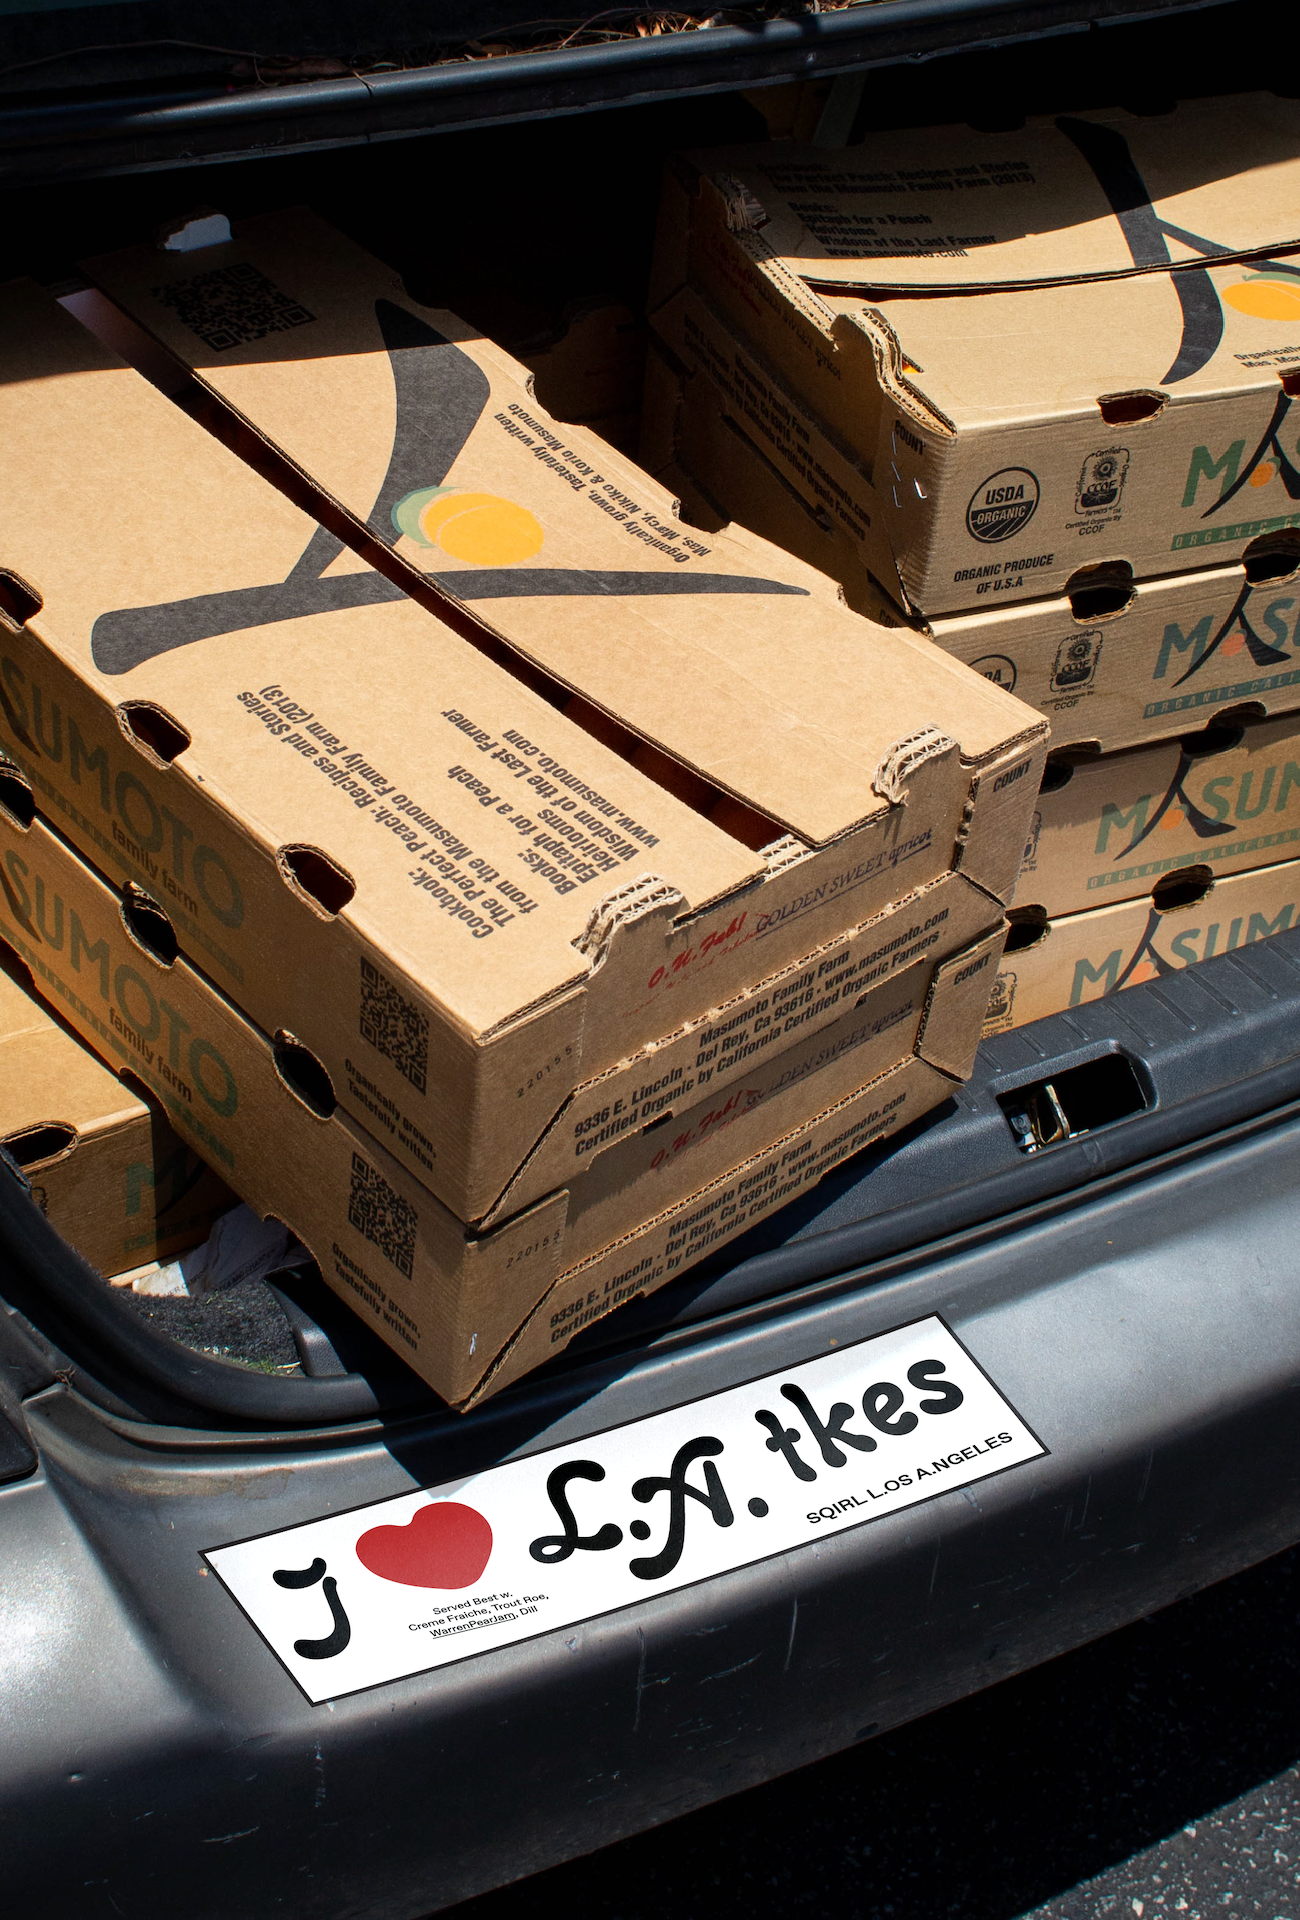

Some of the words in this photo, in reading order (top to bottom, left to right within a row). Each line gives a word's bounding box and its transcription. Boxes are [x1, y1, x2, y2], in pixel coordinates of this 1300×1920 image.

[909, 178, 954, 193] Family
[956, 176, 991, 190] Farm
[992, 171, 1036, 188] (2013)
[955, 164, 980, 176] and
[888, 213, 932, 225] Peach
[875, 235, 889, 247] of
[890, 235, 915, 248] the
[916, 234, 946, 247] Last
[947, 232, 998, 246] Farmer
[494, 413, 535, 446] written
[507, 403, 565, 451] Masumoto
[531, 447, 586, 491] Tastefully
[562, 451, 594, 476] Korio
[590, 473, 606, 486] &
[588, 490, 628, 521] grown,
[603, 485, 641, 514] Nikiko
[985, 485, 1025, 505] USDA
[641, 513, 680, 540] Marcy,
[976, 505, 1026, 524] ORGANIC
[1079, 524, 1105, 536] CCOF
[622, 522, 690, 562] Organically
[682, 537, 711, 556] Mas,
[1176, 520, 1267, 547] ORGANIC
[954, 564, 1001, 583] ORGANIC
[1003, 553, 1054, 575] PRODUCE
[976, 582, 991, 595] OF
[993, 575, 1024, 592] U.S.A
[237, 692, 291, 735] Stories
[259, 685, 314, 724] (2013)
[1054, 699, 1079, 711] CCOF
[1147, 687, 1237, 716] ORGANIC
[281, 733, 319, 757] and
[306, 722, 348, 755] Farm
[441, 710, 499, 752] Farmer
[342, 754, 396, 796] Family
[491, 748, 532, 778] Last
[993, 758, 1033, 793] COUNT
[313, 757, 376, 808] Recipes
[448, 766, 501, 807] Peach
[502, 730, 660, 848] www.masumoto.com
[527, 776, 558, 798] the
[496, 803, 514, 814] a
[550, 796, 577, 811] of
[370, 806, 428, 852] Peach:
[392, 794, 473, 861] Masumoto
[507, 815, 538, 835] for
[537, 809, 620, 872] Heirlooms
[574, 810, 639, 861] Wisdom
[420, 849, 486, 901] Perfect
[468, 859, 500, 883] the
[518, 848, 578, 895] Books:
[533, 833, 599, 883] Epitaph
[827, 851, 887, 893] SWEET
[886, 828, 932, 868] apricot
[1090, 858, 1179, 889] ORGANIC
[163, 868, 201, 918] farm
[408, 868, 494, 938] Cookbook:
[496, 880, 538, 914] from
[481, 898, 515, 927] The
[953, 952, 992, 986] COUNT
[700, 999, 768, 1047] Masumoto
[772, 971, 815, 1005] Family
[818, 951, 850, 978] Farm
[575, 1107, 610, 1138] 9336
[614, 1099, 627, 1116] E.
[632, 1068, 682, 1105] Lincoln
[696, 1044, 718, 1068] Del
[722, 1030, 749, 1053] Rey,
[754, 1016, 771, 1033] Ca
[774, 988, 814, 1021] 93616
[825, 908, 949, 991] www.masumoto.com
[110, 1007, 155, 1064] family
[158, 1055, 193, 1103] farm
[576, 1108, 638, 1156] Certified
[641, 1079, 694, 1117] Organic
[698, 1067, 714, 1084] by
[717, 1027, 781, 1072] California
[784, 988, 840, 1032] Certified
[842, 962, 888, 997] Organic
[891, 931, 939, 968] Farmers
[345, 1059, 400, 1121] Organically
[403, 1117, 436, 1158] grown,
[348, 1078, 396, 1134] Tastefully
[399, 1130, 432, 1171] written
[669, 1190, 734, 1238] Masumoto
[738, 1161, 779, 1195] Family
[781, 1140, 812, 1166] Farm
[550, 1298, 583, 1328] 9336
[587, 1289, 599, 1306] E.
[604, 1257, 652, 1294] Lincoln
[665, 1233, 686, 1256] Del
[690, 1218, 716, 1240] Rey,
[720, 1204, 736, 1220] Ca
[740, 1175, 778, 1208] 93616
[788, 1092, 906, 1176] www.masumoto.com
[551, 1296, 610, 1343] Certified
[613, 1266, 663, 1303] Organic
[667, 1254, 682, 1270] by
[685, 1212, 746, 1258] California
[749, 1173, 802, 1216] Certified
[804, 1145, 848, 1180] Organic
[850, 1113, 897, 1150] Farmers
[332, 1242, 386, 1302] Organically
[389, 1299, 420, 1338] grown,
[335, 1260, 381, 1314] Tastefully
[384, 1310, 417, 1350] written
[754, 1357, 966, 1483] tkes
[807, 1496, 868, 1523] SQIRL
[867, 1475, 912, 1499] L.OS
[917, 1433, 1012, 1480] A.NGELES
[409, 1619, 445, 1630] Creme
[447, 1609, 491, 1622] Fraiche,
[491, 1600, 522, 1610] Trout
[523, 1595, 548, 1603] Roe,
[433, 1600, 471, 1614] Served
[473, 1594, 498, 1605] Best
[430, 1613, 518, 1639] WarrenPearJam,
[520, 1606, 538, 1615] Dill
